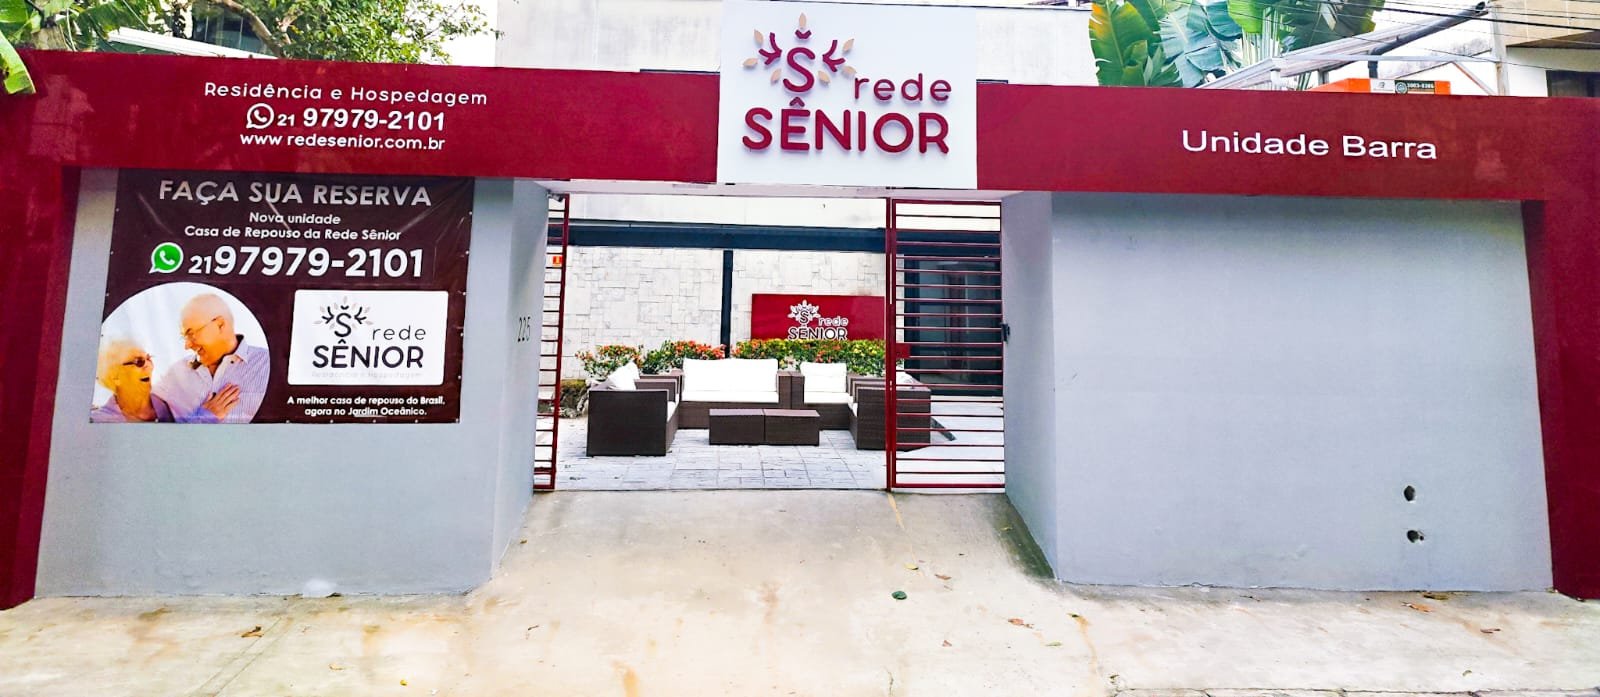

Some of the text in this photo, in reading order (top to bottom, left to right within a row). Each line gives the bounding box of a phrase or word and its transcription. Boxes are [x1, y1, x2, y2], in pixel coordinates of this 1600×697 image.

[204, 82, 488, 106] Residência e Hospedagem
[855, 73, 952, 101] rede
[277, 107, 446, 131] 21 97979-2101
[742, 96, 949, 154] SÊNIOR
[1182, 129, 1437, 160] Unidade Barra
[159, 180, 432, 207] FAÇA SUA RESERVA
[249, 211, 341, 225] Nova unidade
[184, 225, 401, 241] Casa de Repouso da Rede Sênior
[517, 316, 531, 342] 225
[818, 315, 849, 326] rede
[372, 325, 426, 341] rede
[312, 338, 424, 369] SÊNIOR
[286, 395, 295, 405] A
[296, 395, 329, 405] melhor
[329, 397, 352, 405] casa
[353, 395, 367, 405] de
[368, 397, 405, 407] repouso
[405, 395, 419, 405] do
[304, 406, 428, 417] agora no Jardim Oceânico.
